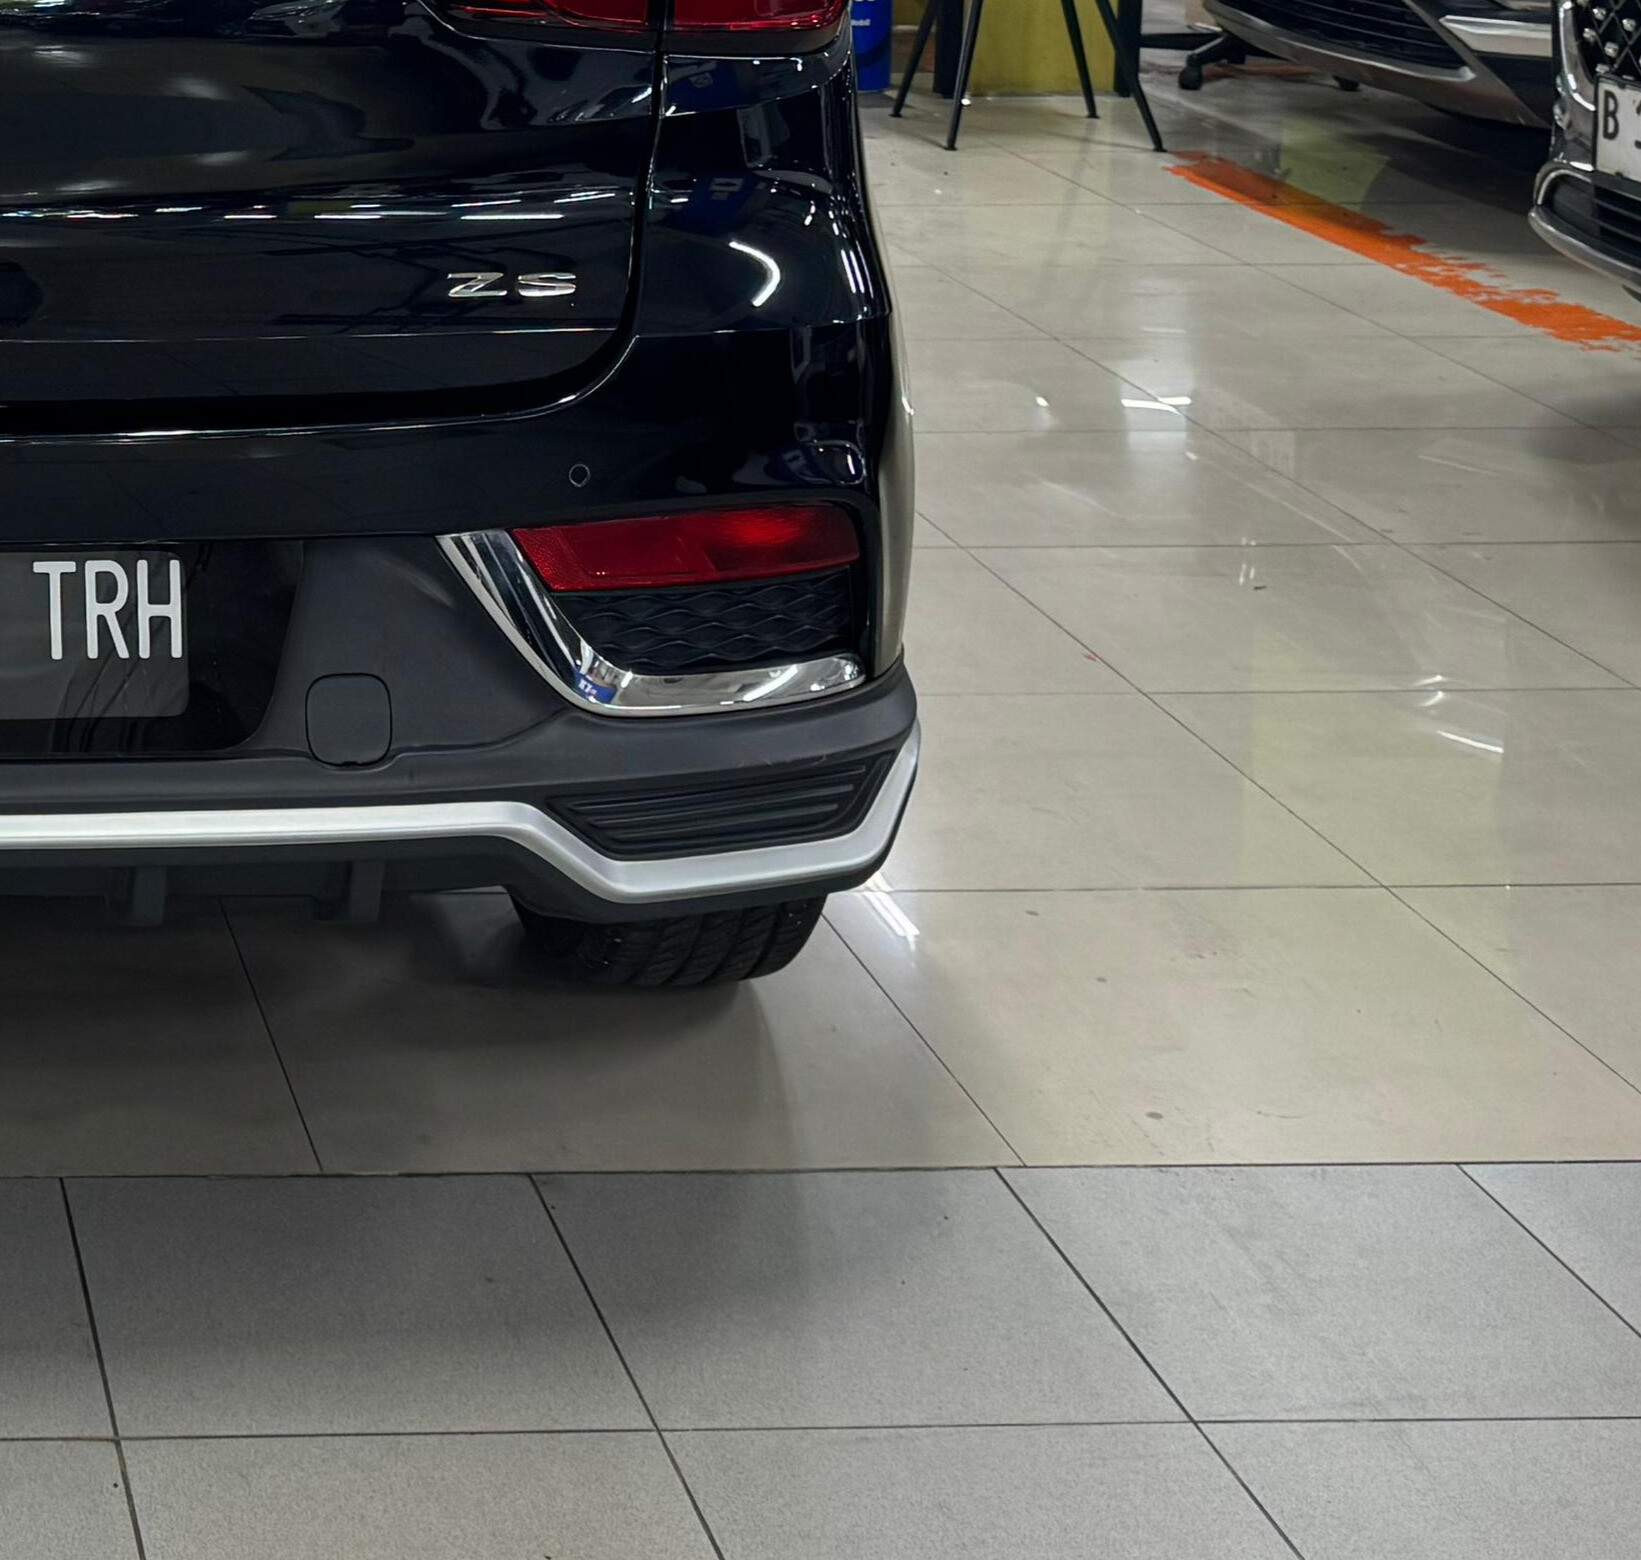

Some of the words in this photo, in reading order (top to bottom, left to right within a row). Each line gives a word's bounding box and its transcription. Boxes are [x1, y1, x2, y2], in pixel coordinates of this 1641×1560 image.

[1602, 89, 1620, 141] B
[447, 272, 577, 297] ZS
[32, 558, 184, 662] TRH
